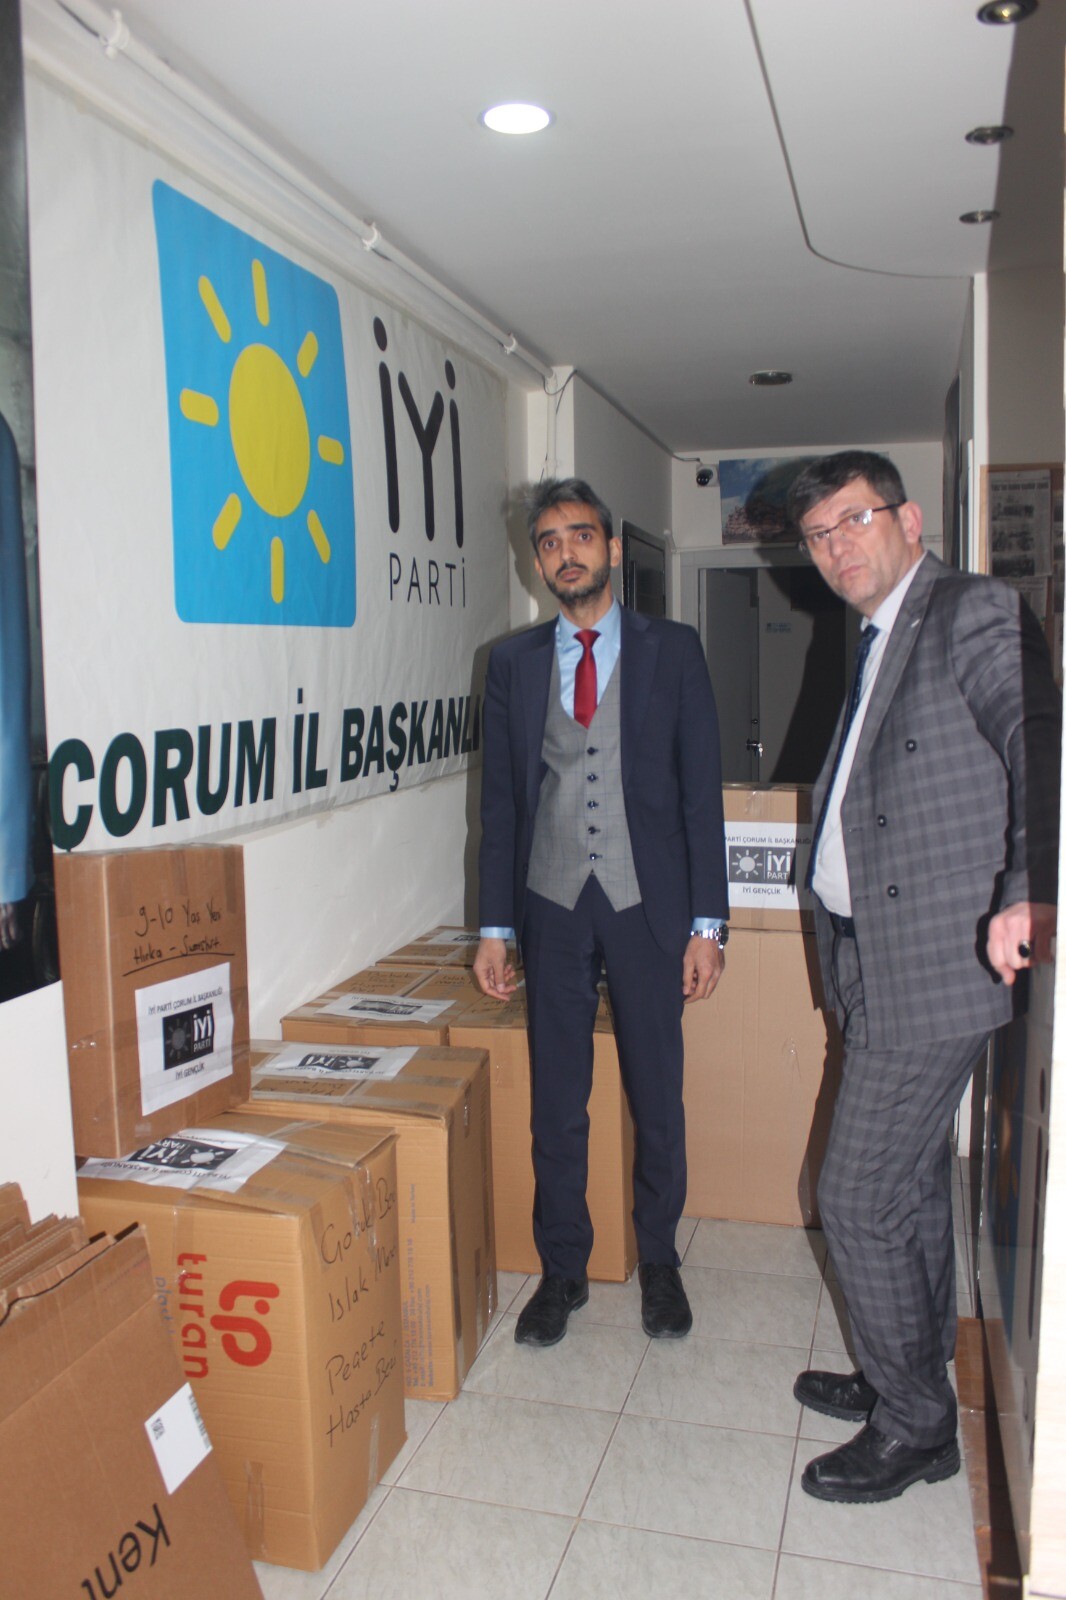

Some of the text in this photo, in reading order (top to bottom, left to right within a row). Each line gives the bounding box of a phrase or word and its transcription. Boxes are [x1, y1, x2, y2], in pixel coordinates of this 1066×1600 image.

[373, 316, 464, 548] İYİ
[389, 552, 466, 608] PARTİ
[292, 688, 328, 793] İL
[767, 850, 791, 872] İYİ
[767, 871, 789, 880] PART
[193, 1009, 212, 1042] İYİ
[137, 1144, 180, 1164] İYİ
[154, 1139, 186, 1150] PART
[177, 1252, 209, 1379] turan
